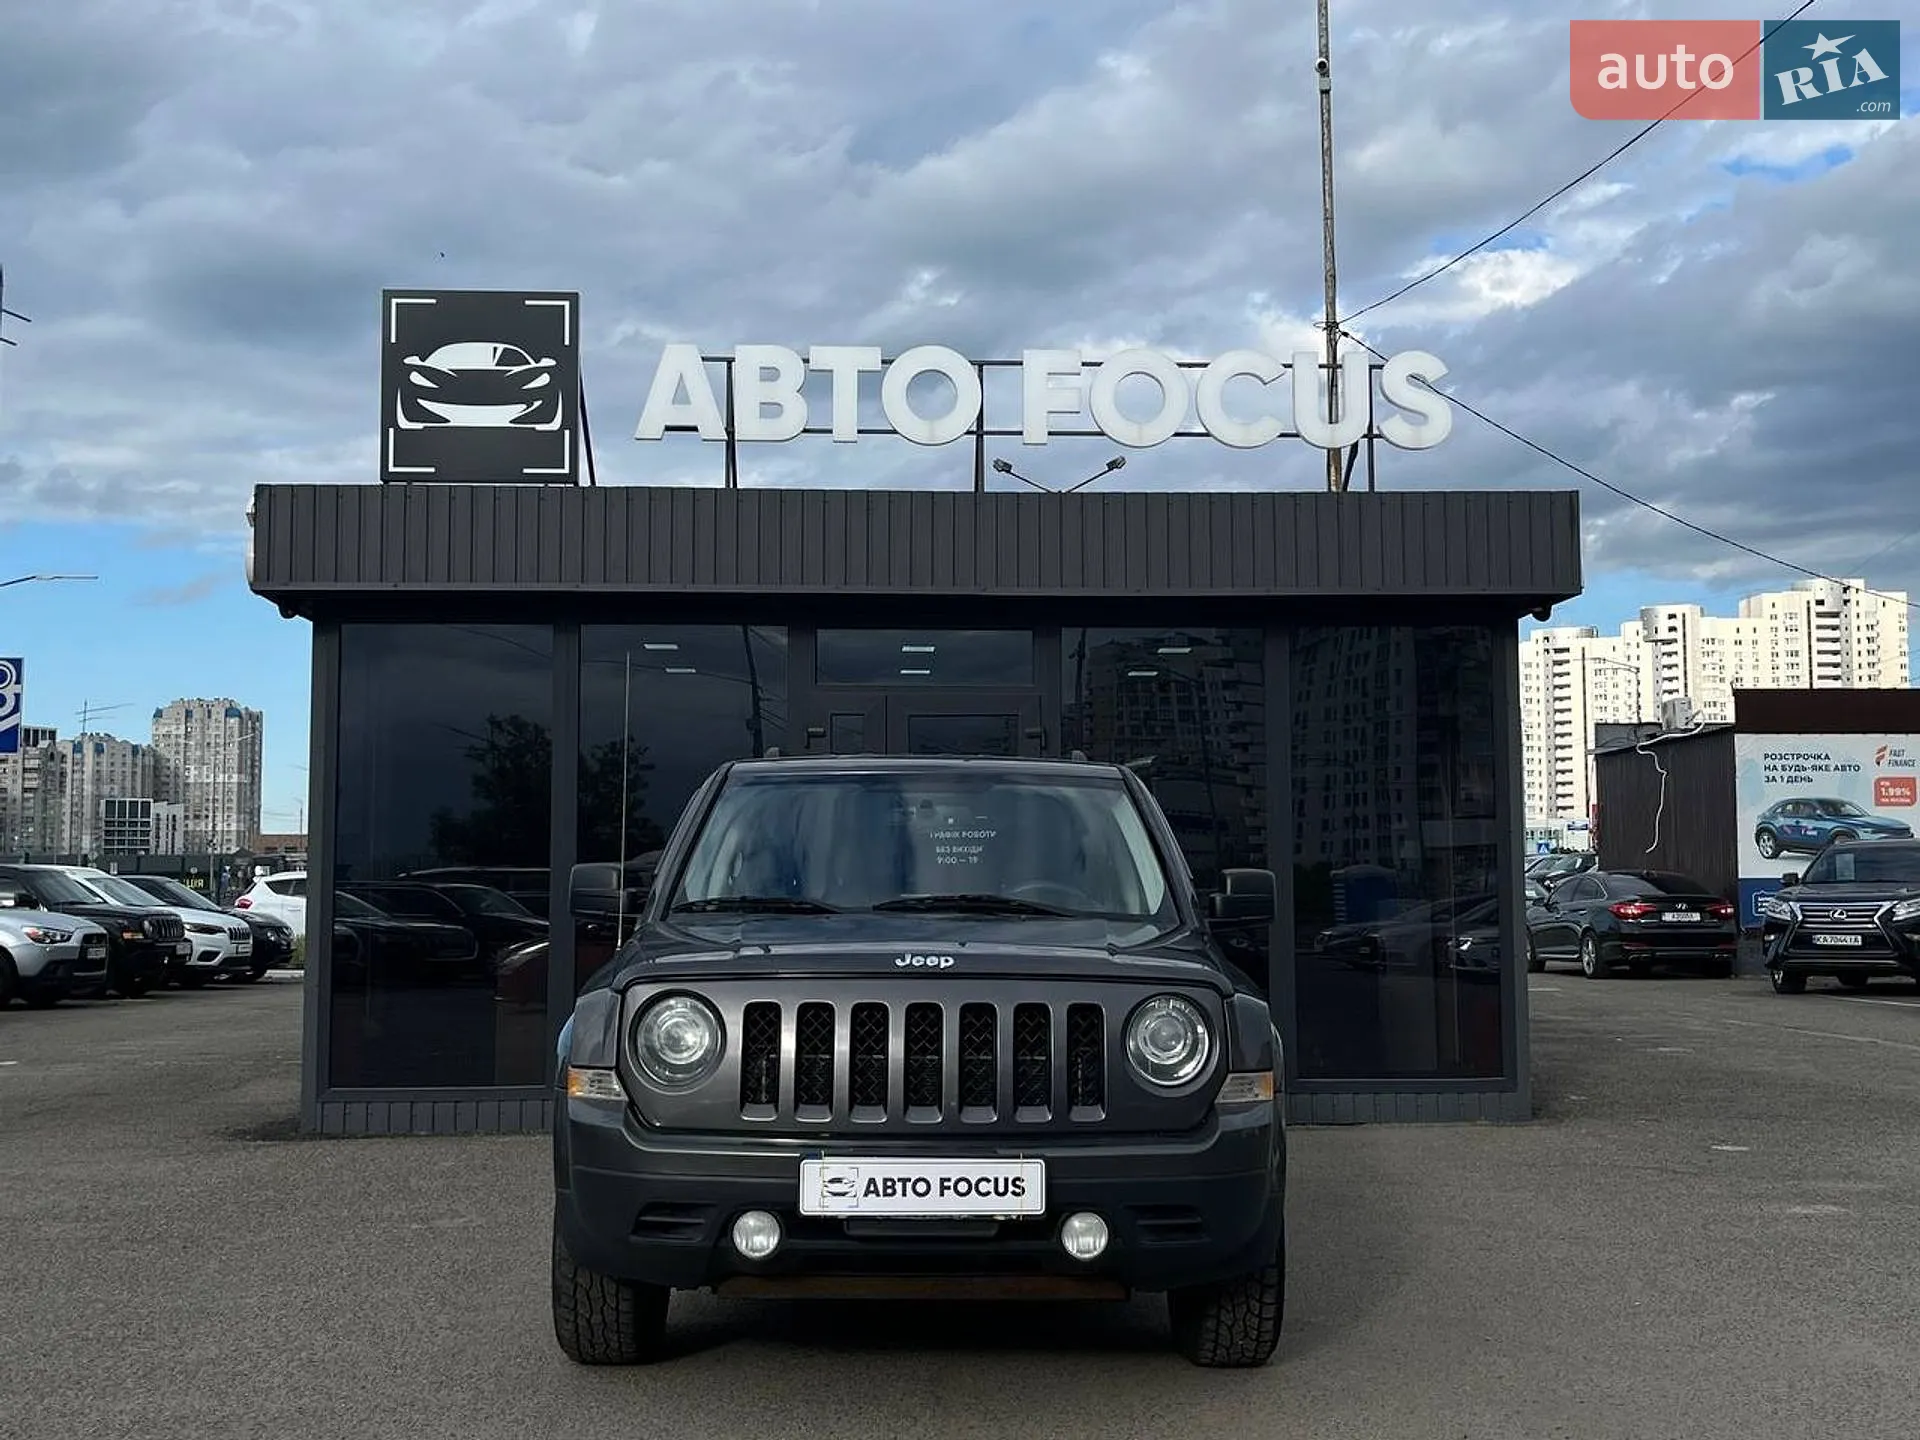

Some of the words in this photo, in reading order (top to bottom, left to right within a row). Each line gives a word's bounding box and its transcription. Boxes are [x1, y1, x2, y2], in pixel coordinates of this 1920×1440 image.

[634, 344, 984, 446] АВТО
[1021, 347, 1453, 450] FOCUS
[1763, 752, 1831, 761] РОЗСТРОЧКА
[1887, 758, 1917, 768] FINANCE
[1763, 764, 1780, 772] НА
[1781, 764, 1832, 773] БУДЬ-ЯКЕ
[1833, 764, 1861, 772] АВТО
[1763, 775, 1778, 783] ЗА
[1786, 775, 1814, 784] ДЕНЬ
[895, 953, 955, 969] Jeep
[863, 1176, 932, 1198] АВТО
[938, 1176, 1026, 1198] FOCUS
